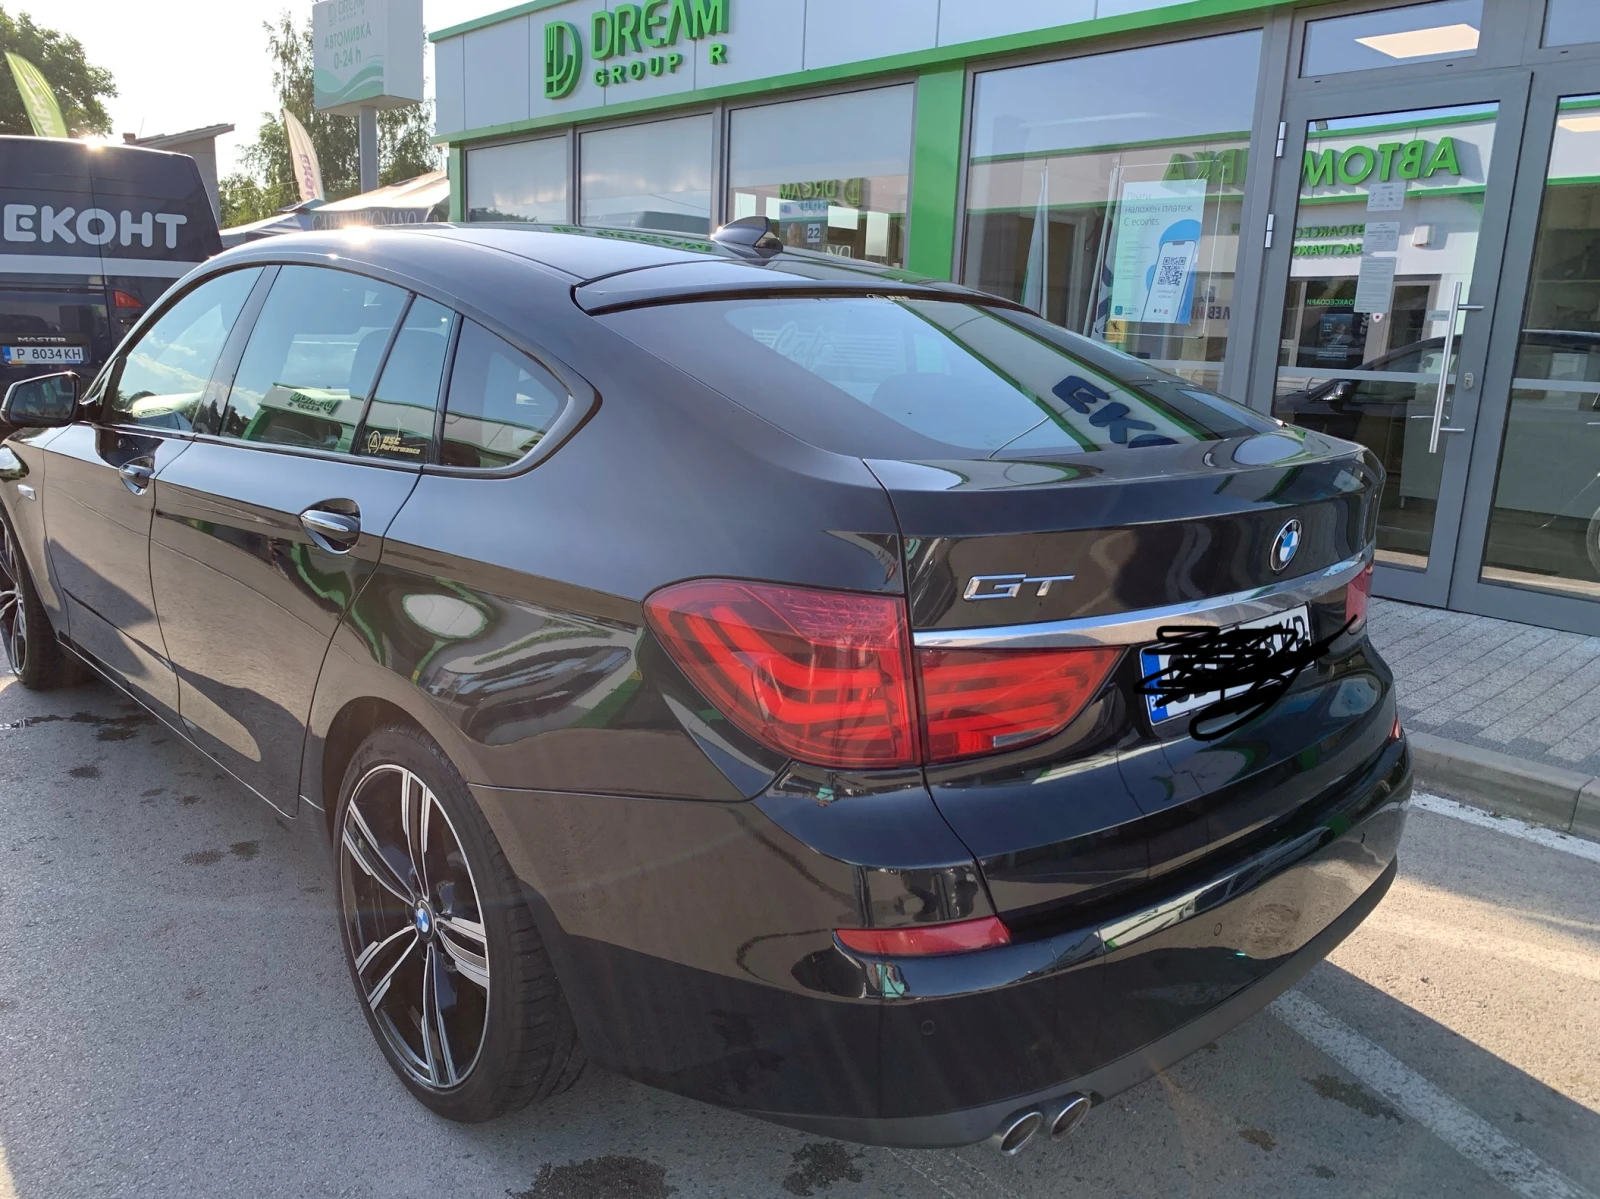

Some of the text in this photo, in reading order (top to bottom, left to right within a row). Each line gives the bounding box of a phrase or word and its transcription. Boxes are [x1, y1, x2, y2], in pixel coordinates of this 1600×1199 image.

[323, 22, 372, 51] АВТОМИВКА
[591, 0, 729, 61] DREAM
[333, 46, 362, 70] 0-24 h
[593, 42, 729, 87] GROUP R
[1124, 204, 1162, 214] наложен
[1126, 191, 1152, 201] Плати
[3, 203, 188, 250] ЕКОНТ
[808, 228, 820, 239] 22
[17, 348, 26, 360] P
[963, 573, 1077, 601] GT
